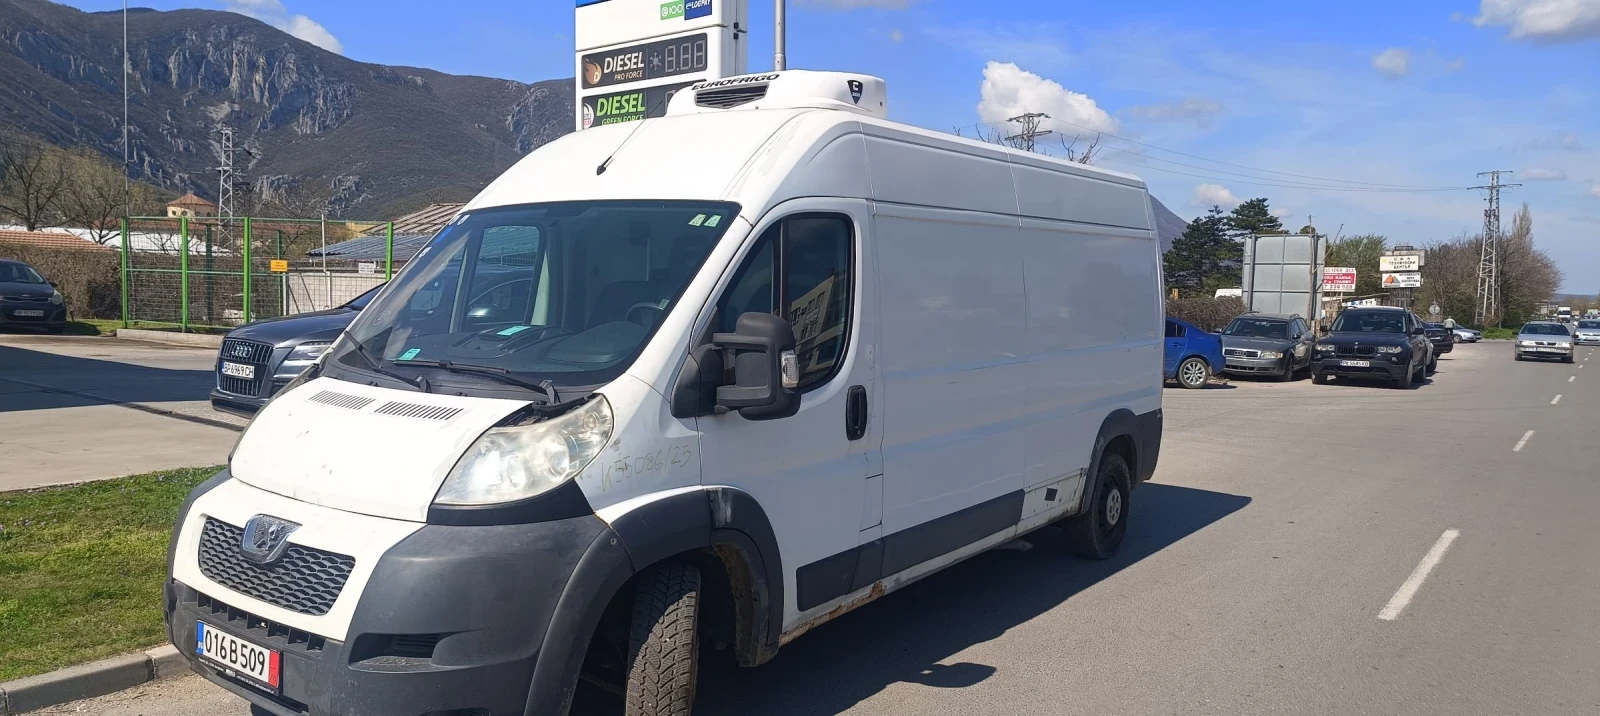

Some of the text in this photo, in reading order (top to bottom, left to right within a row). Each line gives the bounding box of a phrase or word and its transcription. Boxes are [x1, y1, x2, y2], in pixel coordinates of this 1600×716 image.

[604, 52, 645, 74] DIESEL
[614, 70, 643, 81] PRO FORCE
[691, 73, 780, 90] EUROFRIGO
[597, 93, 646, 116] DIESEL
[205, 629, 266, 676] 016B509
